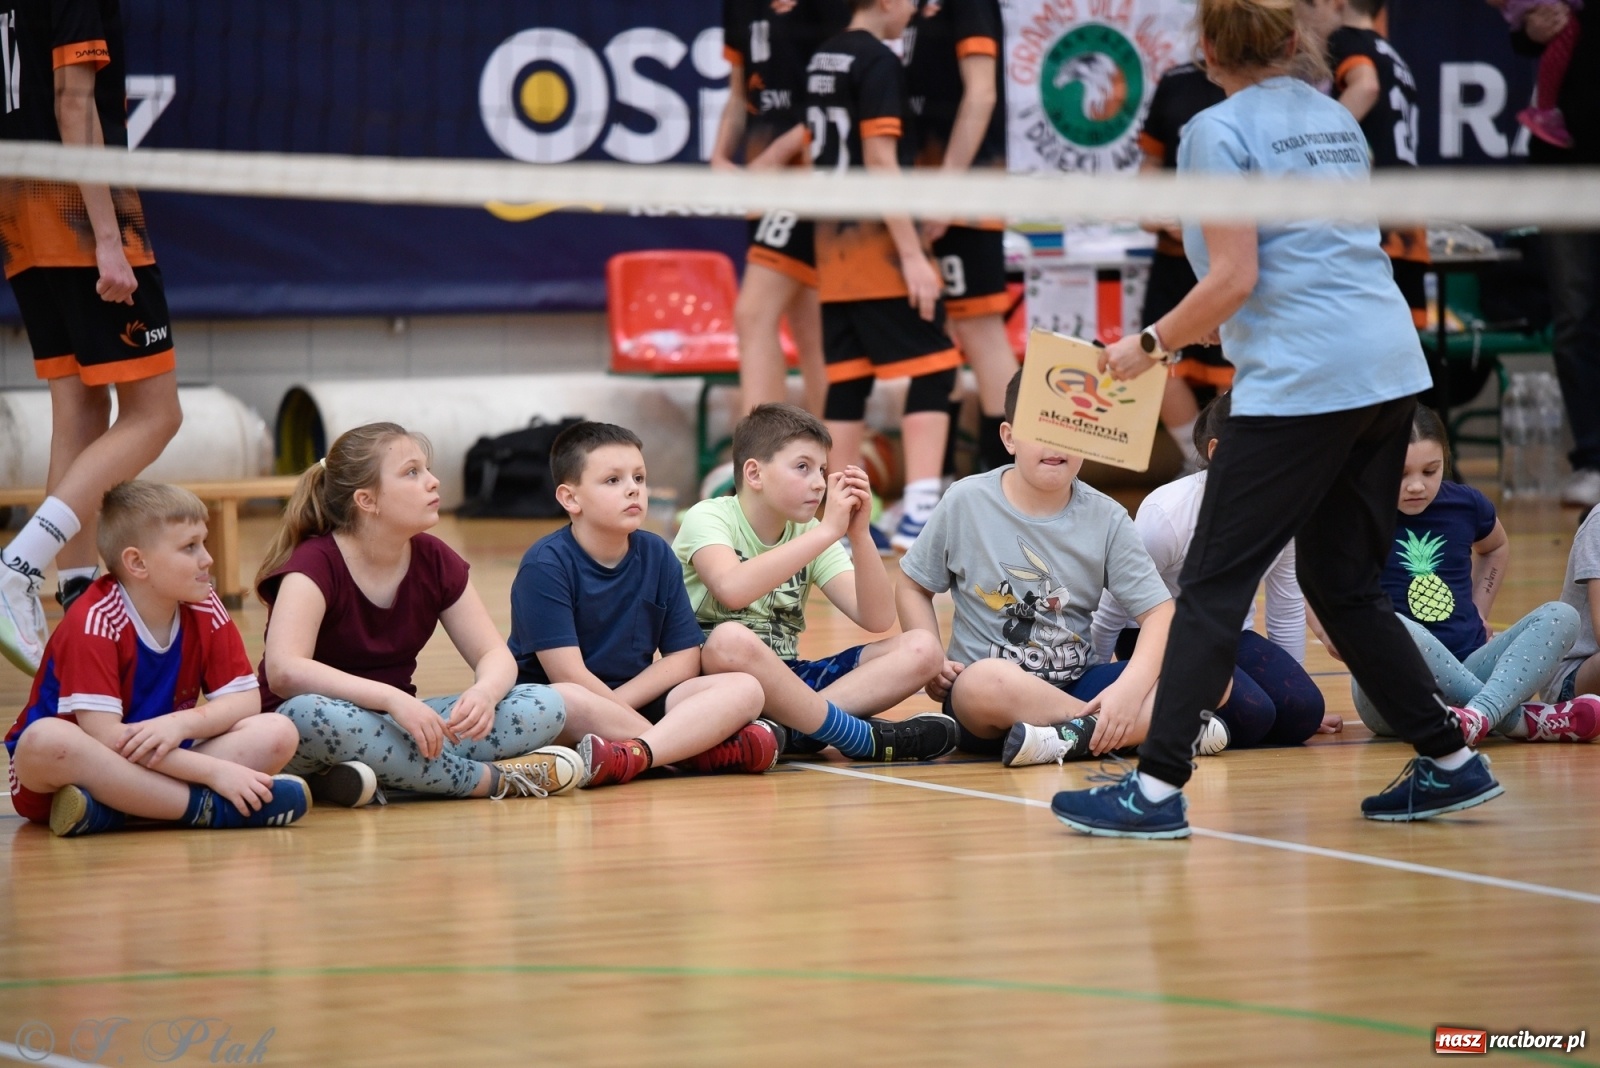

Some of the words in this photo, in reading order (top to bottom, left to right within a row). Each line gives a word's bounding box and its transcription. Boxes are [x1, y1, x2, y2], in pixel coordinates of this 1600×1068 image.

[754, 208, 798, 248] 18
[145, 325, 167, 347] JSW
[1039, 408, 1129, 439] akademia
